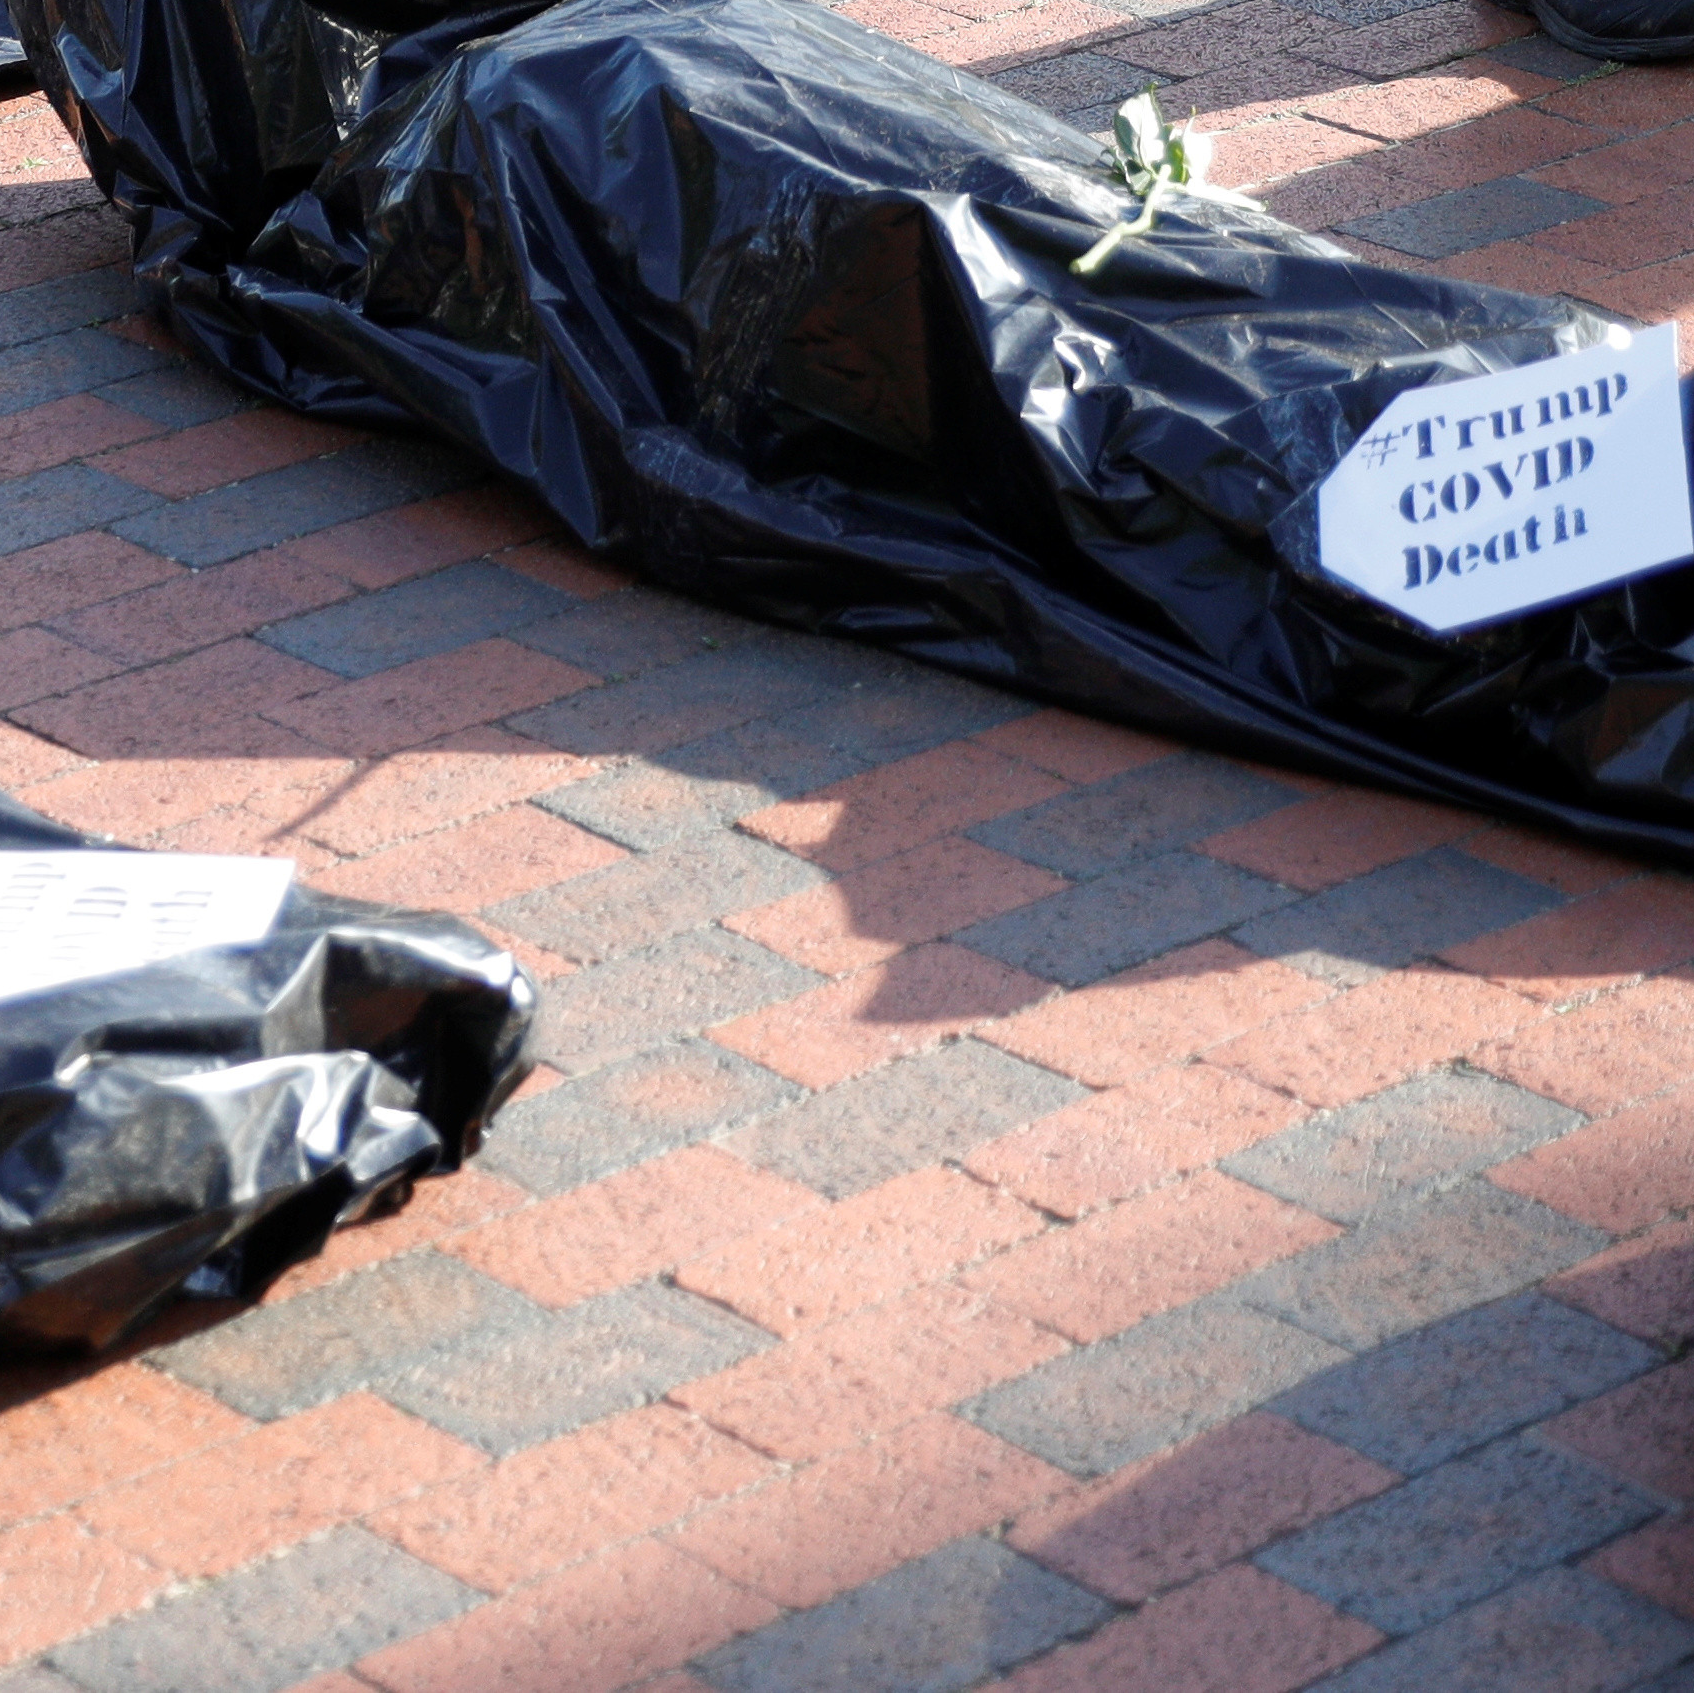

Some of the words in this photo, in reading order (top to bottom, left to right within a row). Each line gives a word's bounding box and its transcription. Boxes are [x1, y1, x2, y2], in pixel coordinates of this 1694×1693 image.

[1361, 372, 1628, 470] #Trump
[1398, 436, 1595, 524] COVID
[1402, 504, 1589, 591] Death
